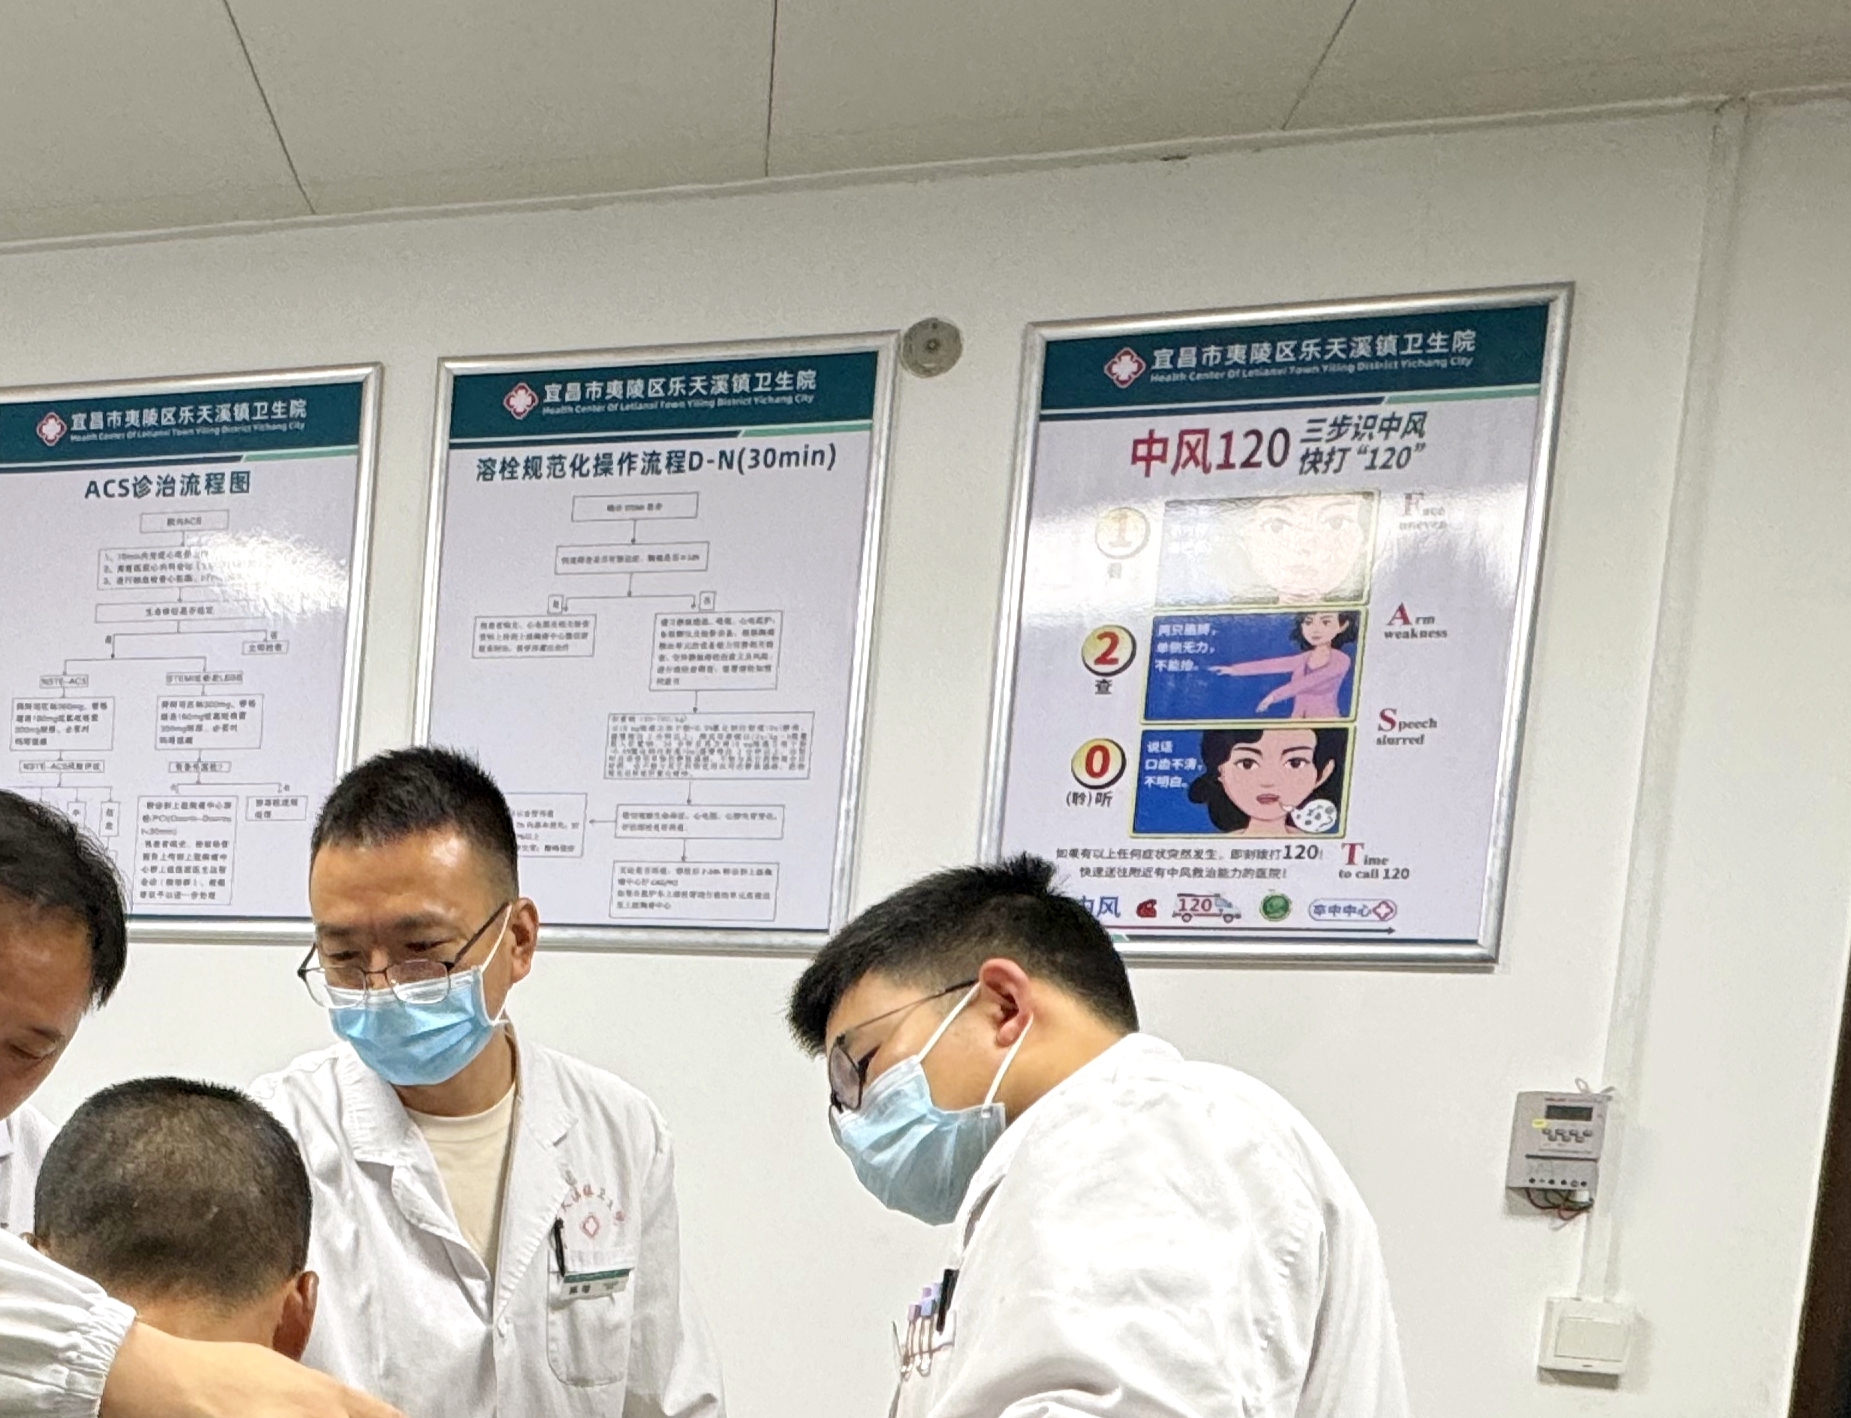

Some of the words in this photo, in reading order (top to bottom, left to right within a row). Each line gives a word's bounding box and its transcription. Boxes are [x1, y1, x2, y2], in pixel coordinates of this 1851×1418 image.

[1151, 330, 1476, 370] 宜昌市夷陵区乐天溪镇卫生院
[1150, 372, 1187, 382] Health
[1189, 370, 1227, 381] Center
[1227, 369, 1241, 379] Of
[1288, 365, 1320, 376] Town
[1401, 357, 1447, 369] Yichang
[1450, 356, 1474, 367] City
[543, 369, 816, 403] 宜昌市夷陵区乐天溪镇卫生院
[794, 393, 815, 404] City
[70, 399, 307, 431] 宜昌市夷陵区乐天溪镇卫生院
[1131, 427, 1290, 478] 中风120
[1300, 411, 1428, 443] 三步识中风
[475, 443, 838, 482] 溶栓规范化操作流程D-N(30min)
[1298, 442, 1426, 475] 快打“120”
[84, 470, 251, 500] ACS诊治流程图
[1386, 602, 1436, 626] Arm
[1384, 627, 1448, 640] weakness
[1093, 631, 1120, 666] 2
[1095, 679, 1113, 695] 查
[1377, 708, 1438, 732] Speech
[1147, 741, 1173, 753] 说话
[1376, 734, 1426, 746] slurred
[1085, 744, 1111, 779] 0
[1341, 842, 1390, 866] Time
[1338, 869, 1352, 879] to
[1355, 868, 1379, 879] call
[1382, 867, 1410, 880] 120
[1179, 898, 1213, 912] 120
[1313, 904, 1372, 917] 卒中中心
